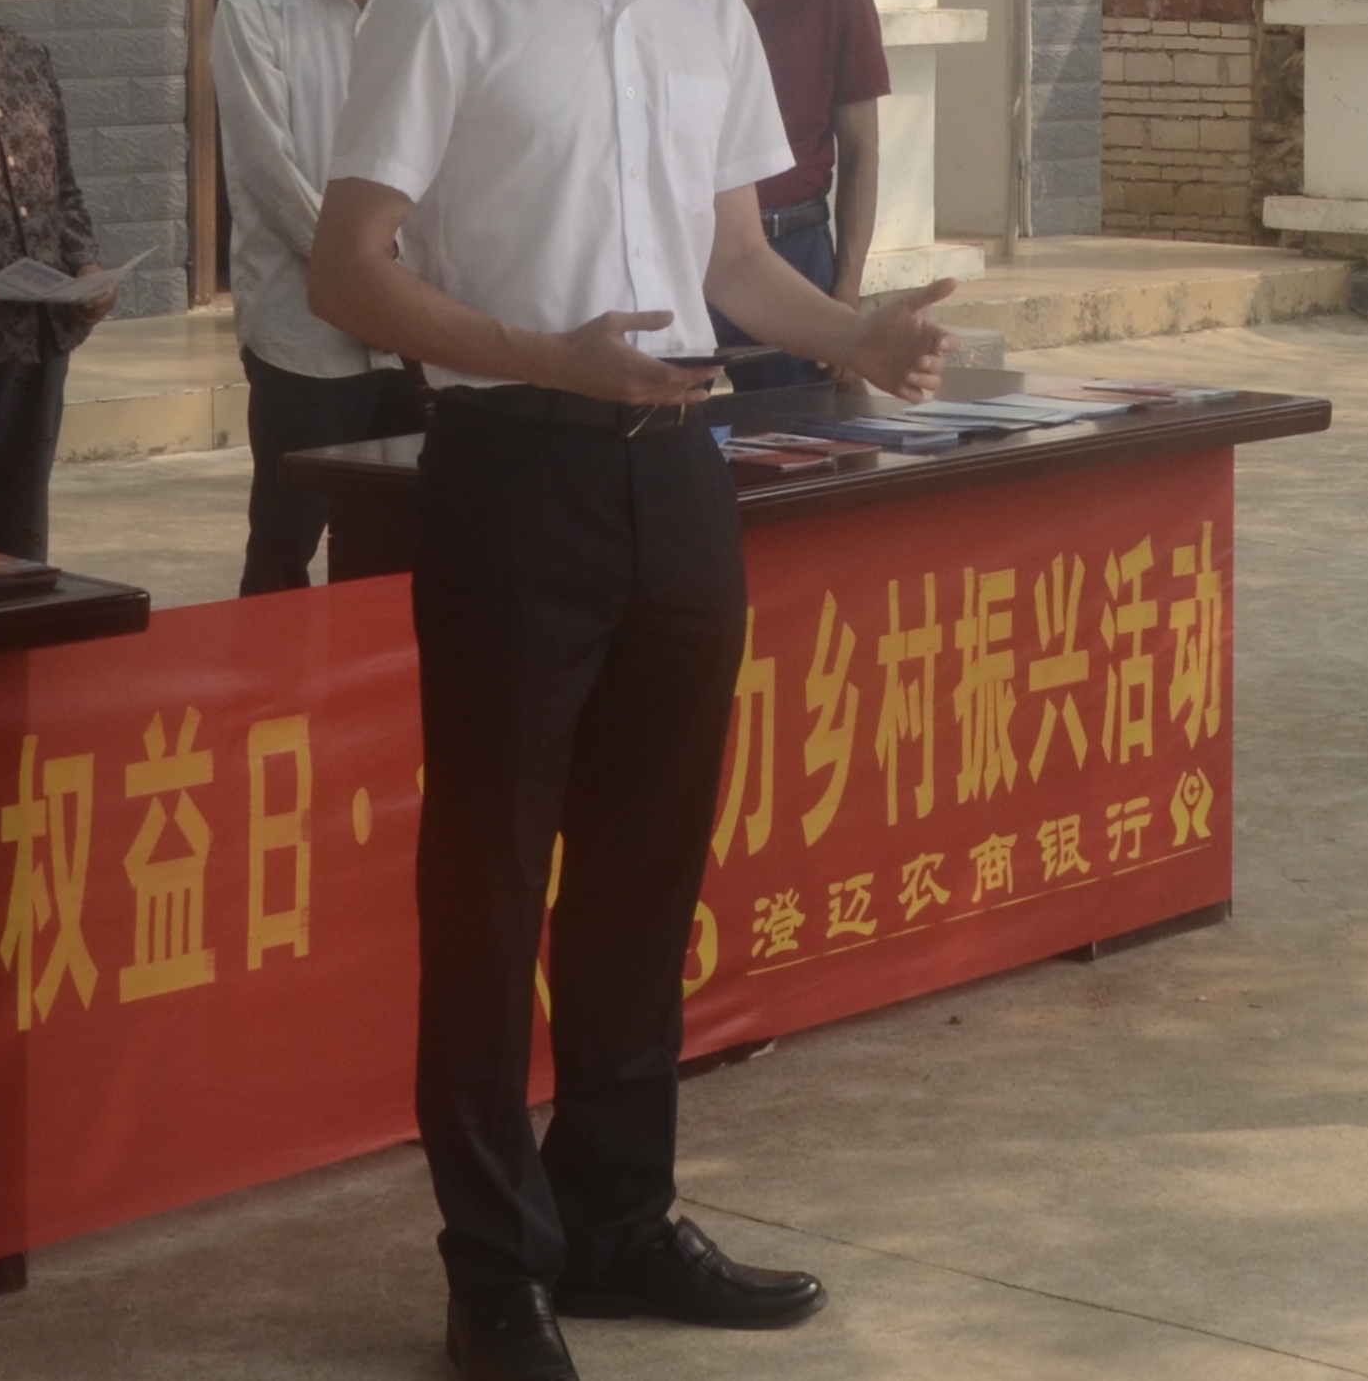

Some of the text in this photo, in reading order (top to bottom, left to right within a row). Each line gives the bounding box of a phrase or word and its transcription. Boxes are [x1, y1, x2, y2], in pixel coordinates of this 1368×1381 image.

[750, 796, 1153, 960] 澄迈农商银行
